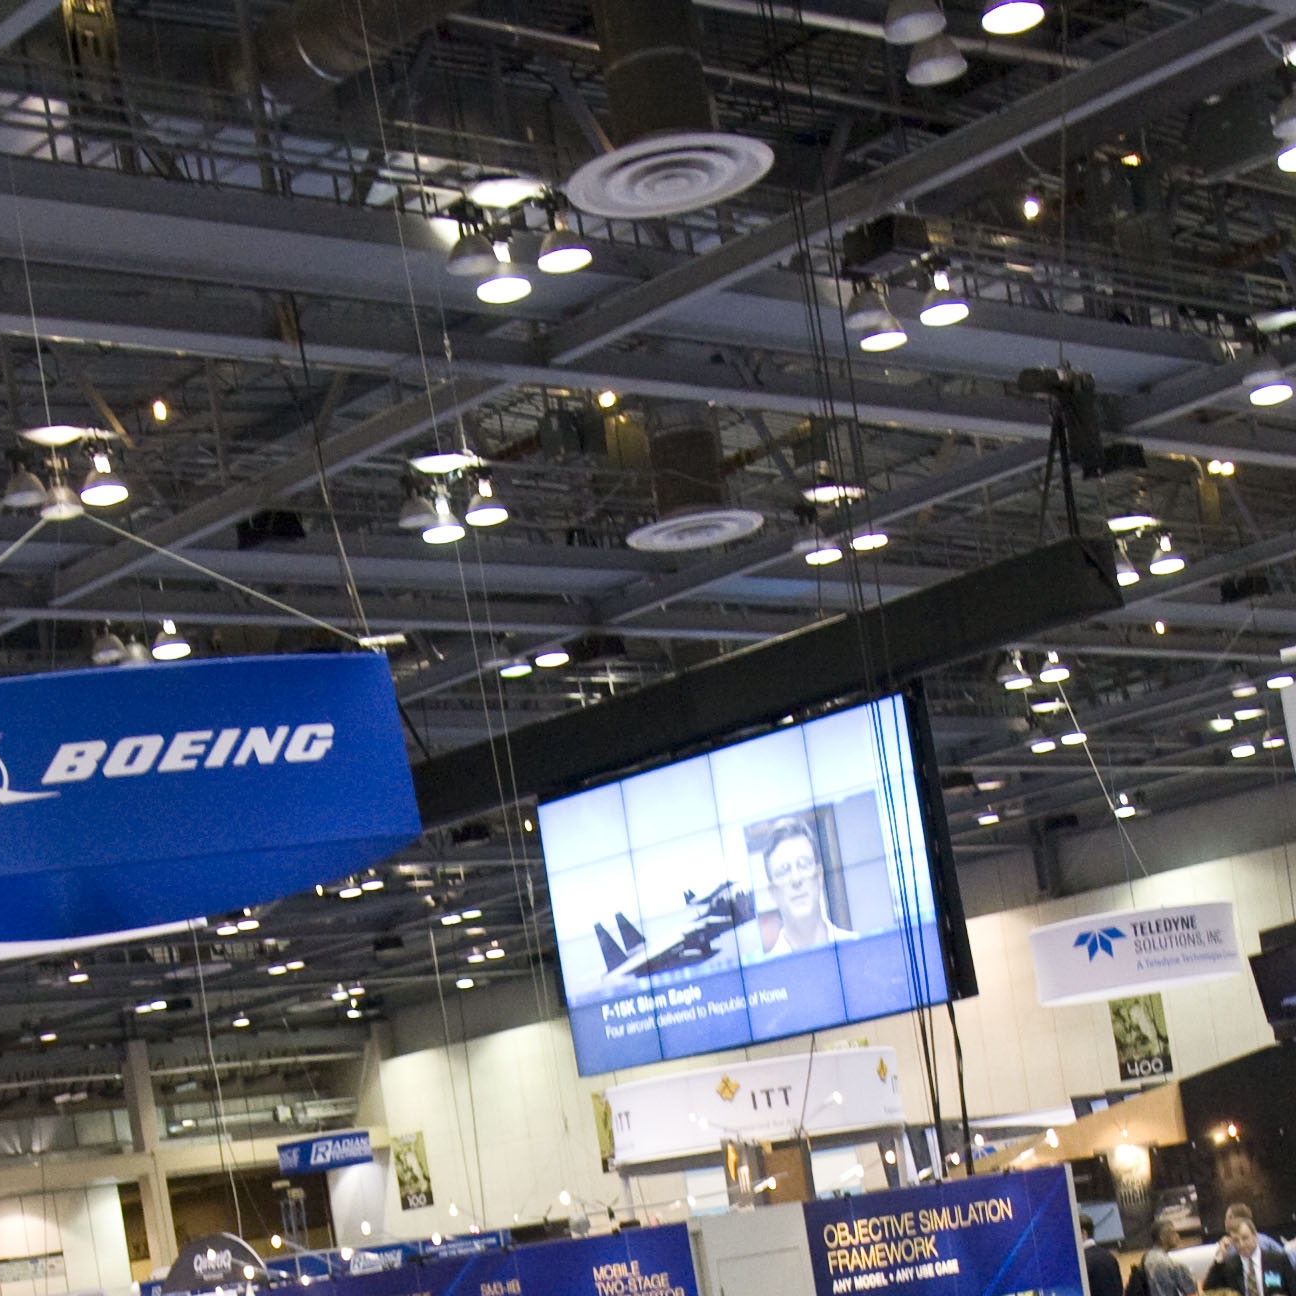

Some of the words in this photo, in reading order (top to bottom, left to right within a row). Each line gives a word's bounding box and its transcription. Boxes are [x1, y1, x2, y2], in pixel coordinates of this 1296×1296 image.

[40, 722, 335, 786] BOEING
[1130, 914, 1197, 937] TELEDYNE
[667, 984, 703, 1007] Eagle
[1126, 1057, 1164, 1078] 400
[750, 1085, 793, 1111] ITT
[823, 1210, 917, 1249] OBJECTIVE
[918, 1196, 1014, 1234] SIMULATION
[827, 1235, 940, 1277] FRAMEWORK
[592, 1259, 640, 1281] MOBILE
[832, 1275, 853, 1295] ANY
[853, 1269, 889, 1292] MODEL
[894, 1265, 915, 1285] ANY
[915, 1261, 935, 1281] USE
[934, 1257, 960, 1277] CASE
[595, 1272, 670, 1296] TWO-STAGE
